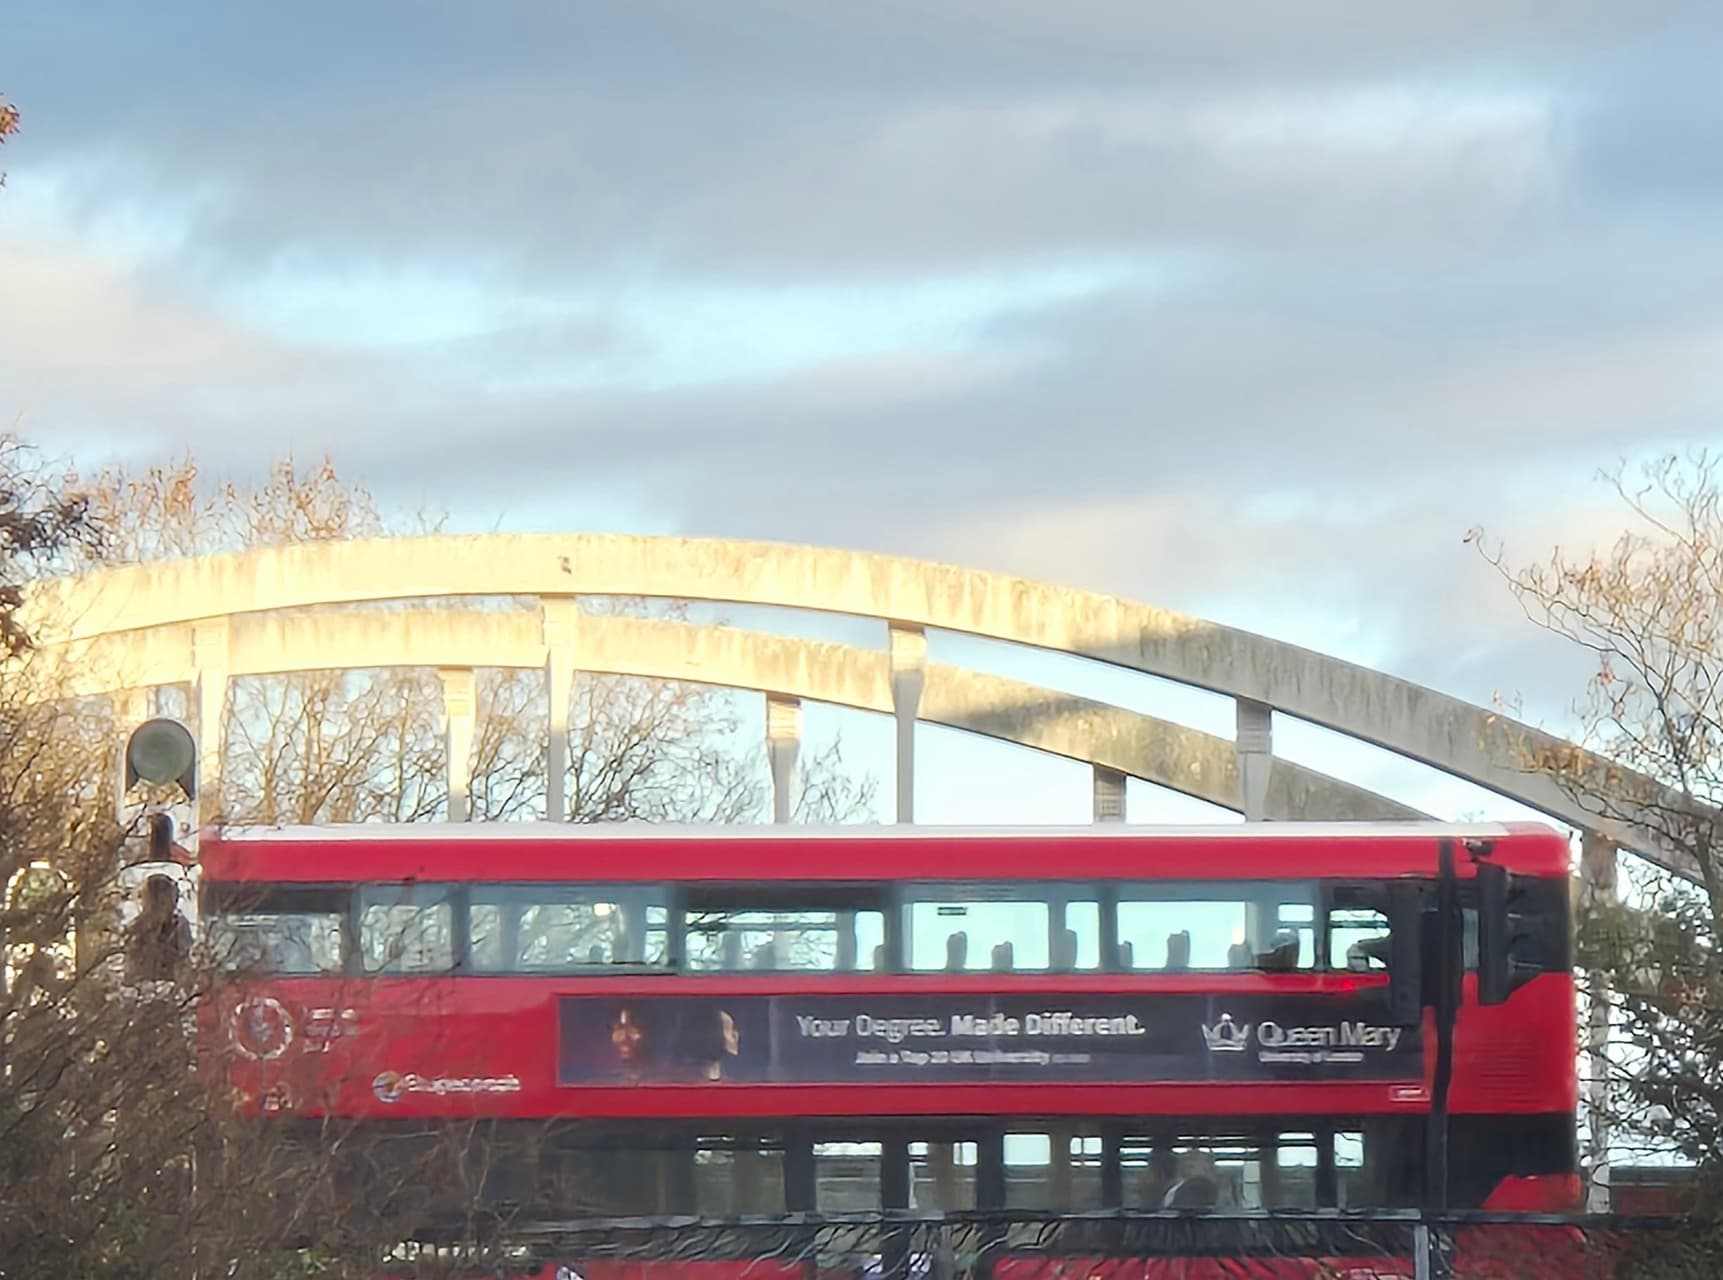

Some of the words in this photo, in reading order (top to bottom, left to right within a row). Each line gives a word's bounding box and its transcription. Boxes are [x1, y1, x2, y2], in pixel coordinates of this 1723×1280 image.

[796, 1015, 850, 1036] Your
[951, 1013, 1020, 1036] Made
[1025, 1012, 1146, 1036] Different.
[1257, 1021, 1335, 1047] Queen
[1340, 1021, 1402, 1052] Mary
